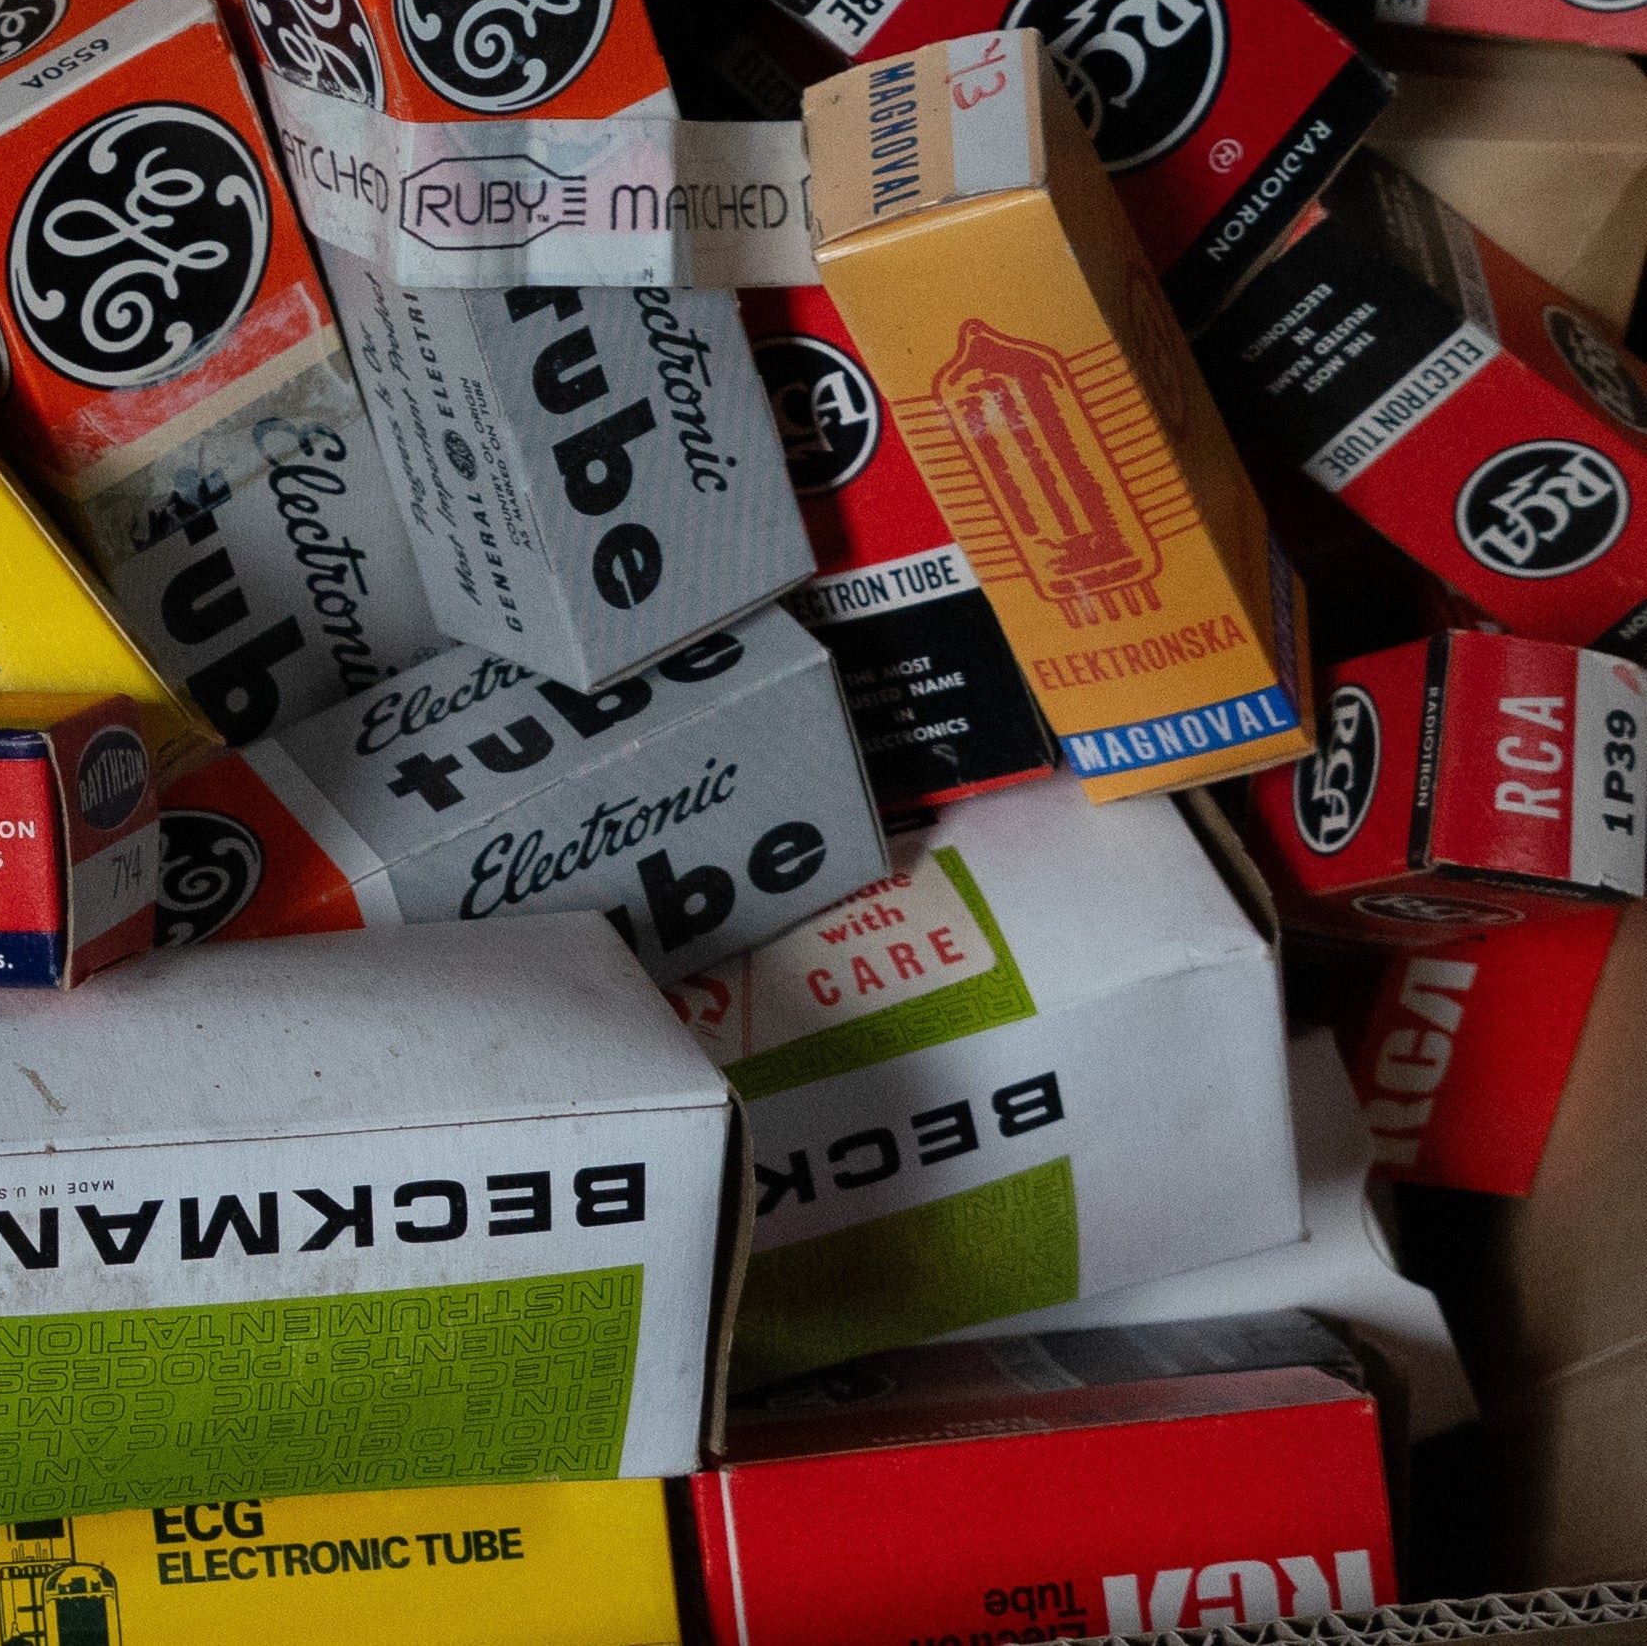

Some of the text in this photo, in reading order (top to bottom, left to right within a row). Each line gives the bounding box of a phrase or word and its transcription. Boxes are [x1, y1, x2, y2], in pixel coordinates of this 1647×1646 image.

[20, 36, 110, 90] 6550A
[869, 60, 923, 216] MAGNOVAL
[416, 181, 788, 230] RUBY MATCHED
[1205, 118, 1334, 263] RADIOTRON
[471, 380, 490, 415] TUBE
[1324, 339, 1484, 479] ELECTRON TUBE
[459, 376, 520, 546] COUNTRY ORIGIN
[502, 287, 663, 612] tube
[1473, 451, 1617, 567] RCA
[449, 534, 482, 606] Most
[467, 493, 523, 632] GENERAL
[888, 554, 961, 609] TUBE
[908, 669, 968, 701] NAME
[1033, 614, 1249, 693] ELEKTRONSKA
[387, 631, 746, 812] tube
[1069, 693, 1290, 772] MAGNOVAL
[1417, 684, 1440, 808] RADIOTRON
[1494, 692, 1566, 820] RCA
[78, 746, 145, 813] RAYTHEON
[1603, 707, 1637, 837] 1P39
[459, 758, 740, 921] Electronic
[816, 905, 906, 945] with
[807, 927, 966, 1007] CARE
[1369, 956, 1479, 1167] RCA
[38, 1179, 114, 1196] MADE IN
[210, 1344, 628, 1416] ELECTRONIC
[464, 1377, 624, 1423] FINE
[189, 1410, 619, 1471] BIOLOGICAL
[153, 1497, 265, 1545] ECG
[157, 1526, 525, 1587] ELECTRONIC TUBE
[984, 1580, 1084, 1621] Tube
